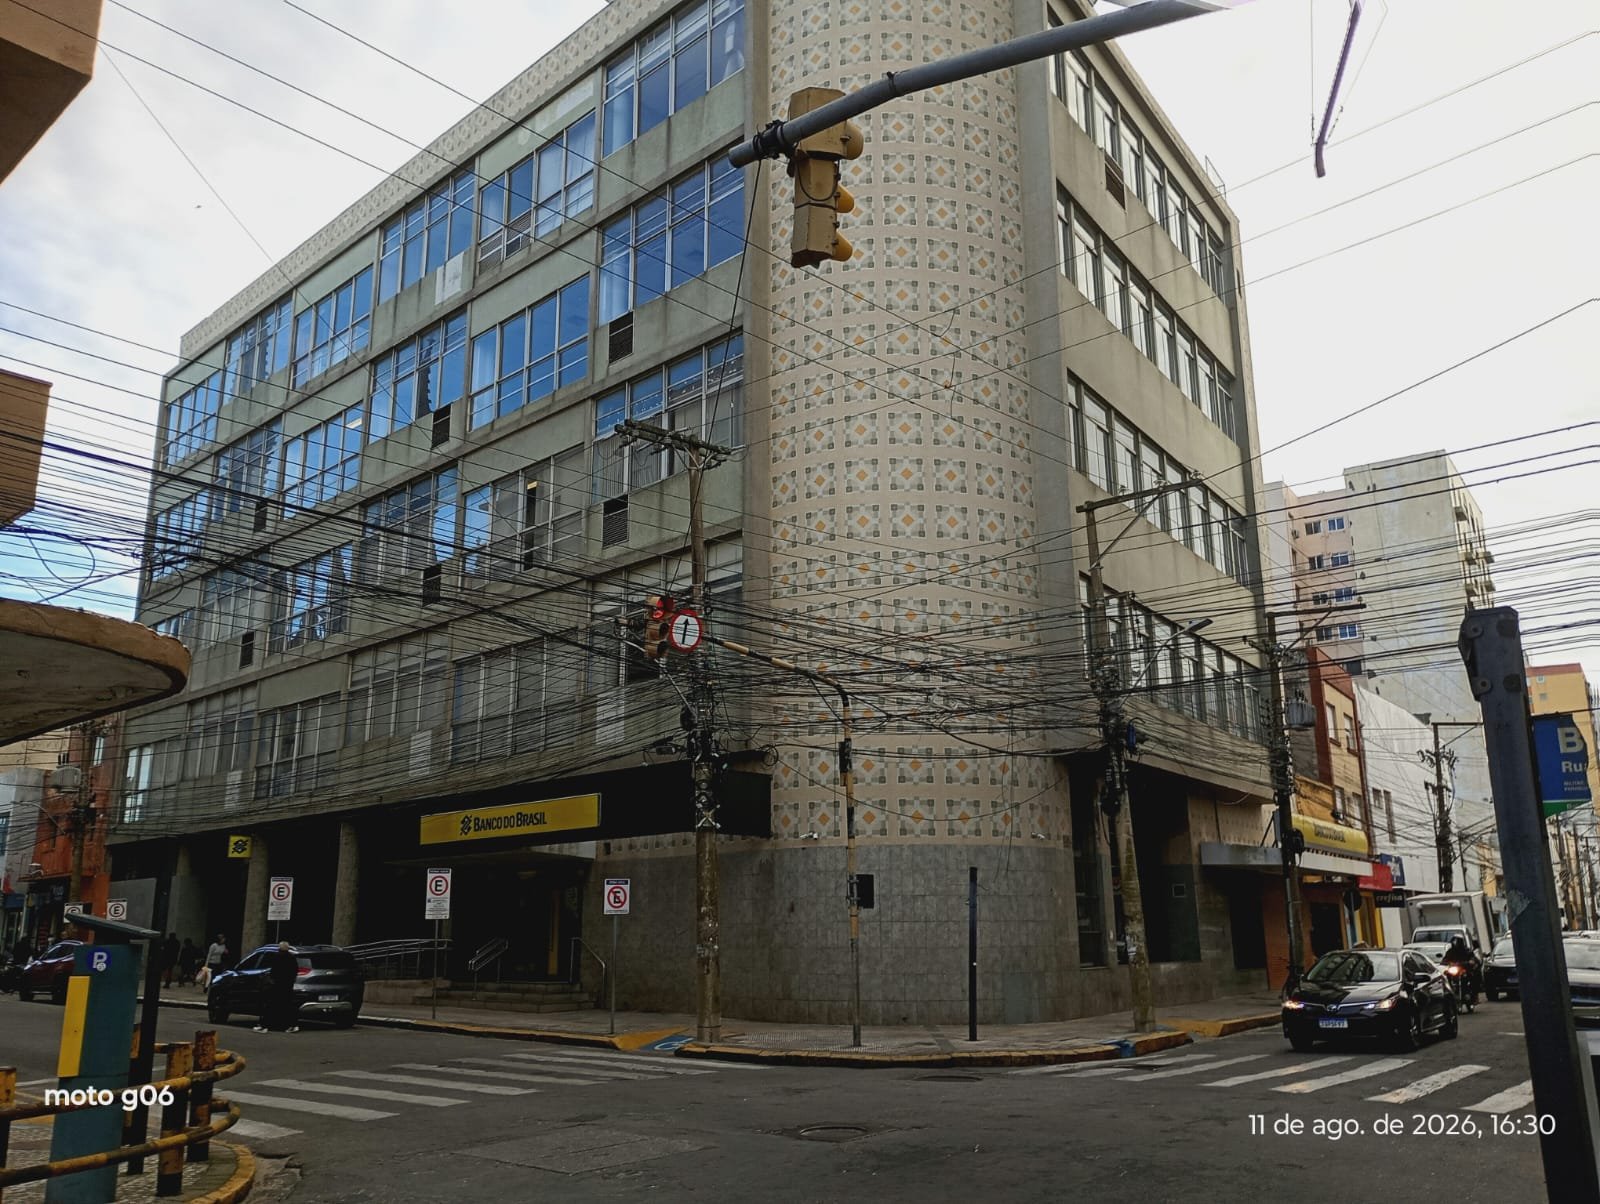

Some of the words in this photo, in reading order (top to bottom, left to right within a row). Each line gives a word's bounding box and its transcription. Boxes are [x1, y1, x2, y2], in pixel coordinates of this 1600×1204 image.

[1557, 727, 1584, 753] B
[1561, 761, 1587, 773] Ru
[473, 816, 501, 832] BANCO
[503, 816, 515, 828] DO
[516, 811, 547, 828] BRASIL
[277, 886, 286, 897] E
[434, 879, 443, 892] E
[113, 905, 121, 915] E
[92, 951, 108, 969] P
